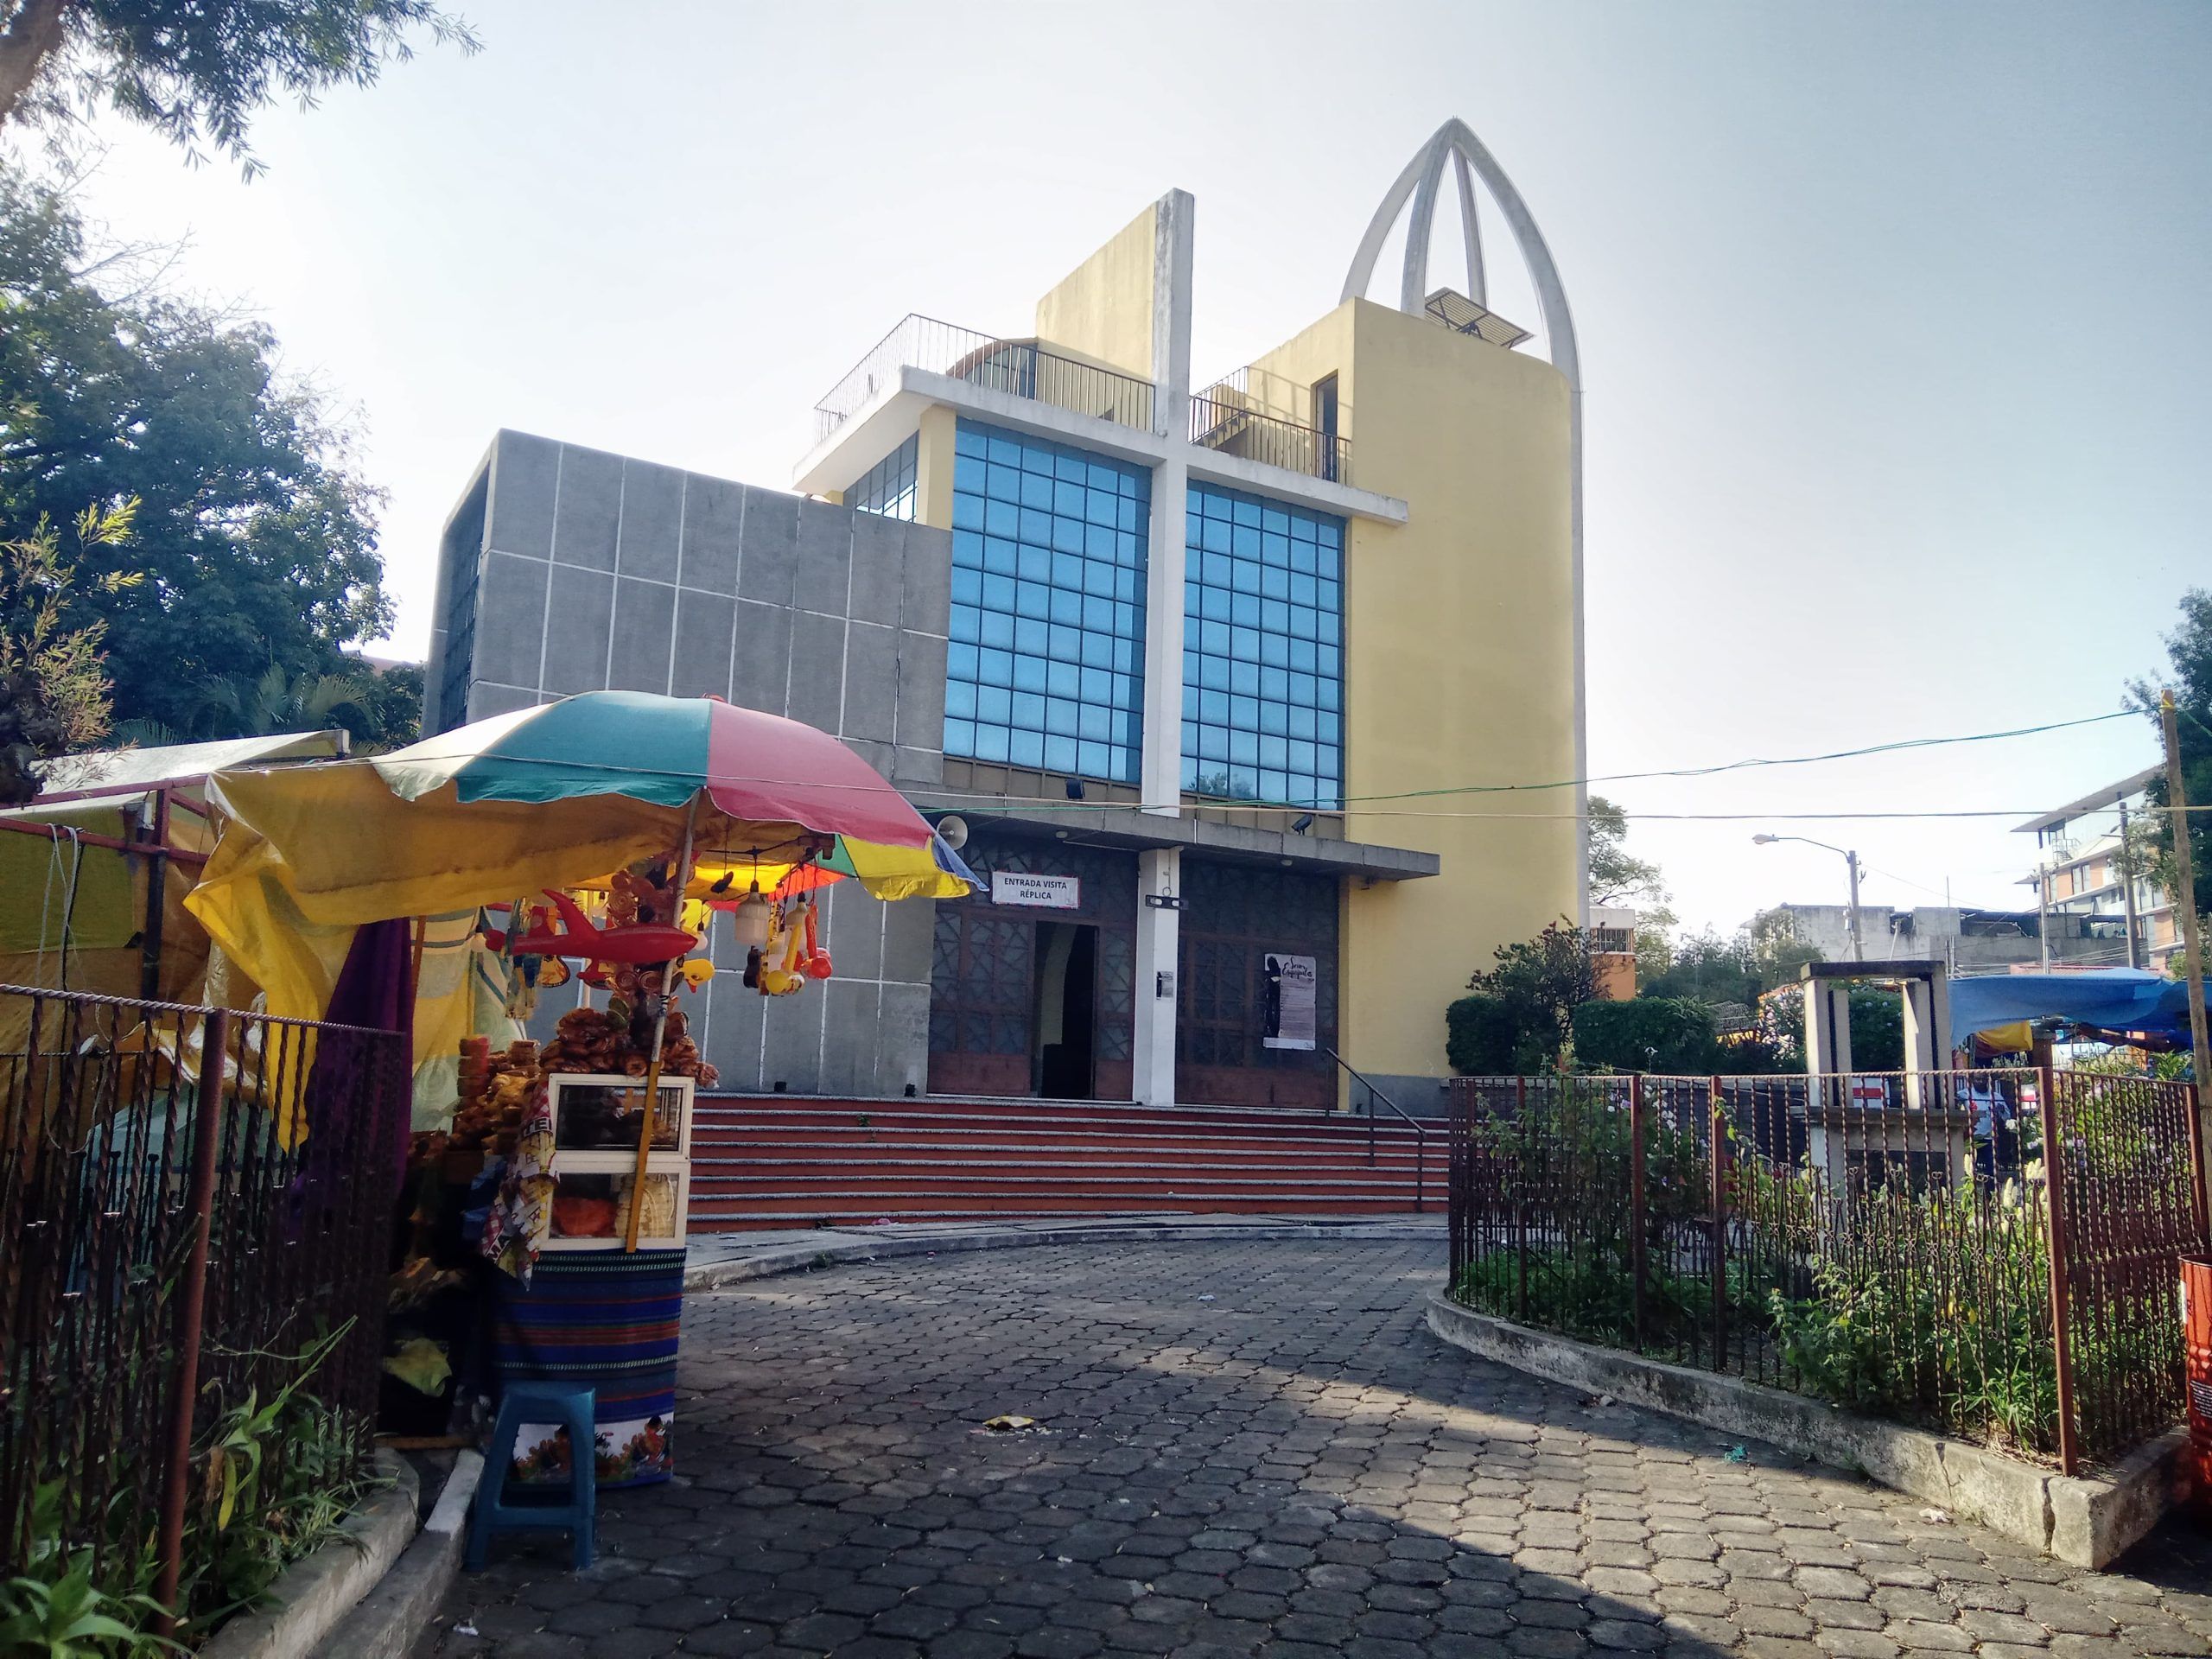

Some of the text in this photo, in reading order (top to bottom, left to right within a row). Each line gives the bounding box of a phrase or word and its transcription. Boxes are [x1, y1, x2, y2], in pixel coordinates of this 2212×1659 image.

[1004, 877, 1067, 889] ENTRADA VISITA
[1020, 889, 1052, 899] RÉPLICA
